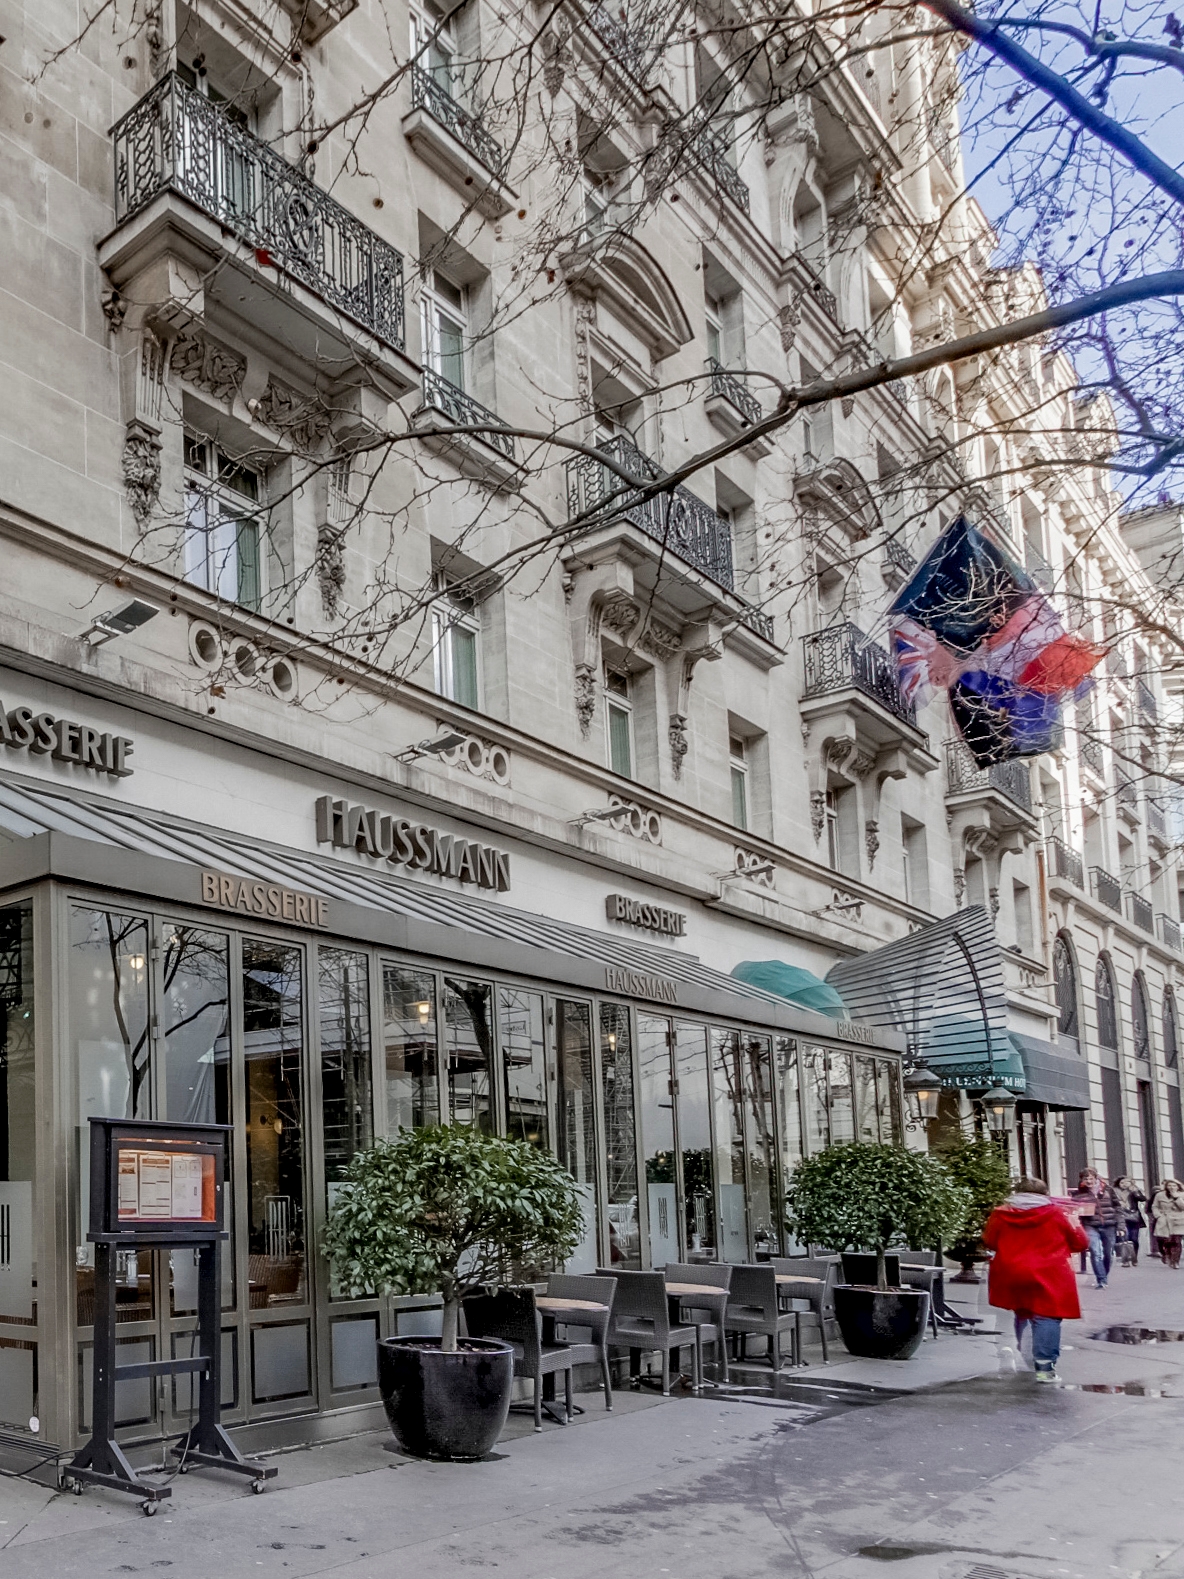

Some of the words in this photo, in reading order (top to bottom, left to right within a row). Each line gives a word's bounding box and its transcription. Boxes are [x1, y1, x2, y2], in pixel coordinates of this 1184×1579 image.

[315, 795, 511, 892] HAUSSMANN
[201, 872, 329, 928] BRASSERIE
[605, 894, 687, 937] BRASSERIE
[605, 968, 677, 1003] HAUSSMANN
